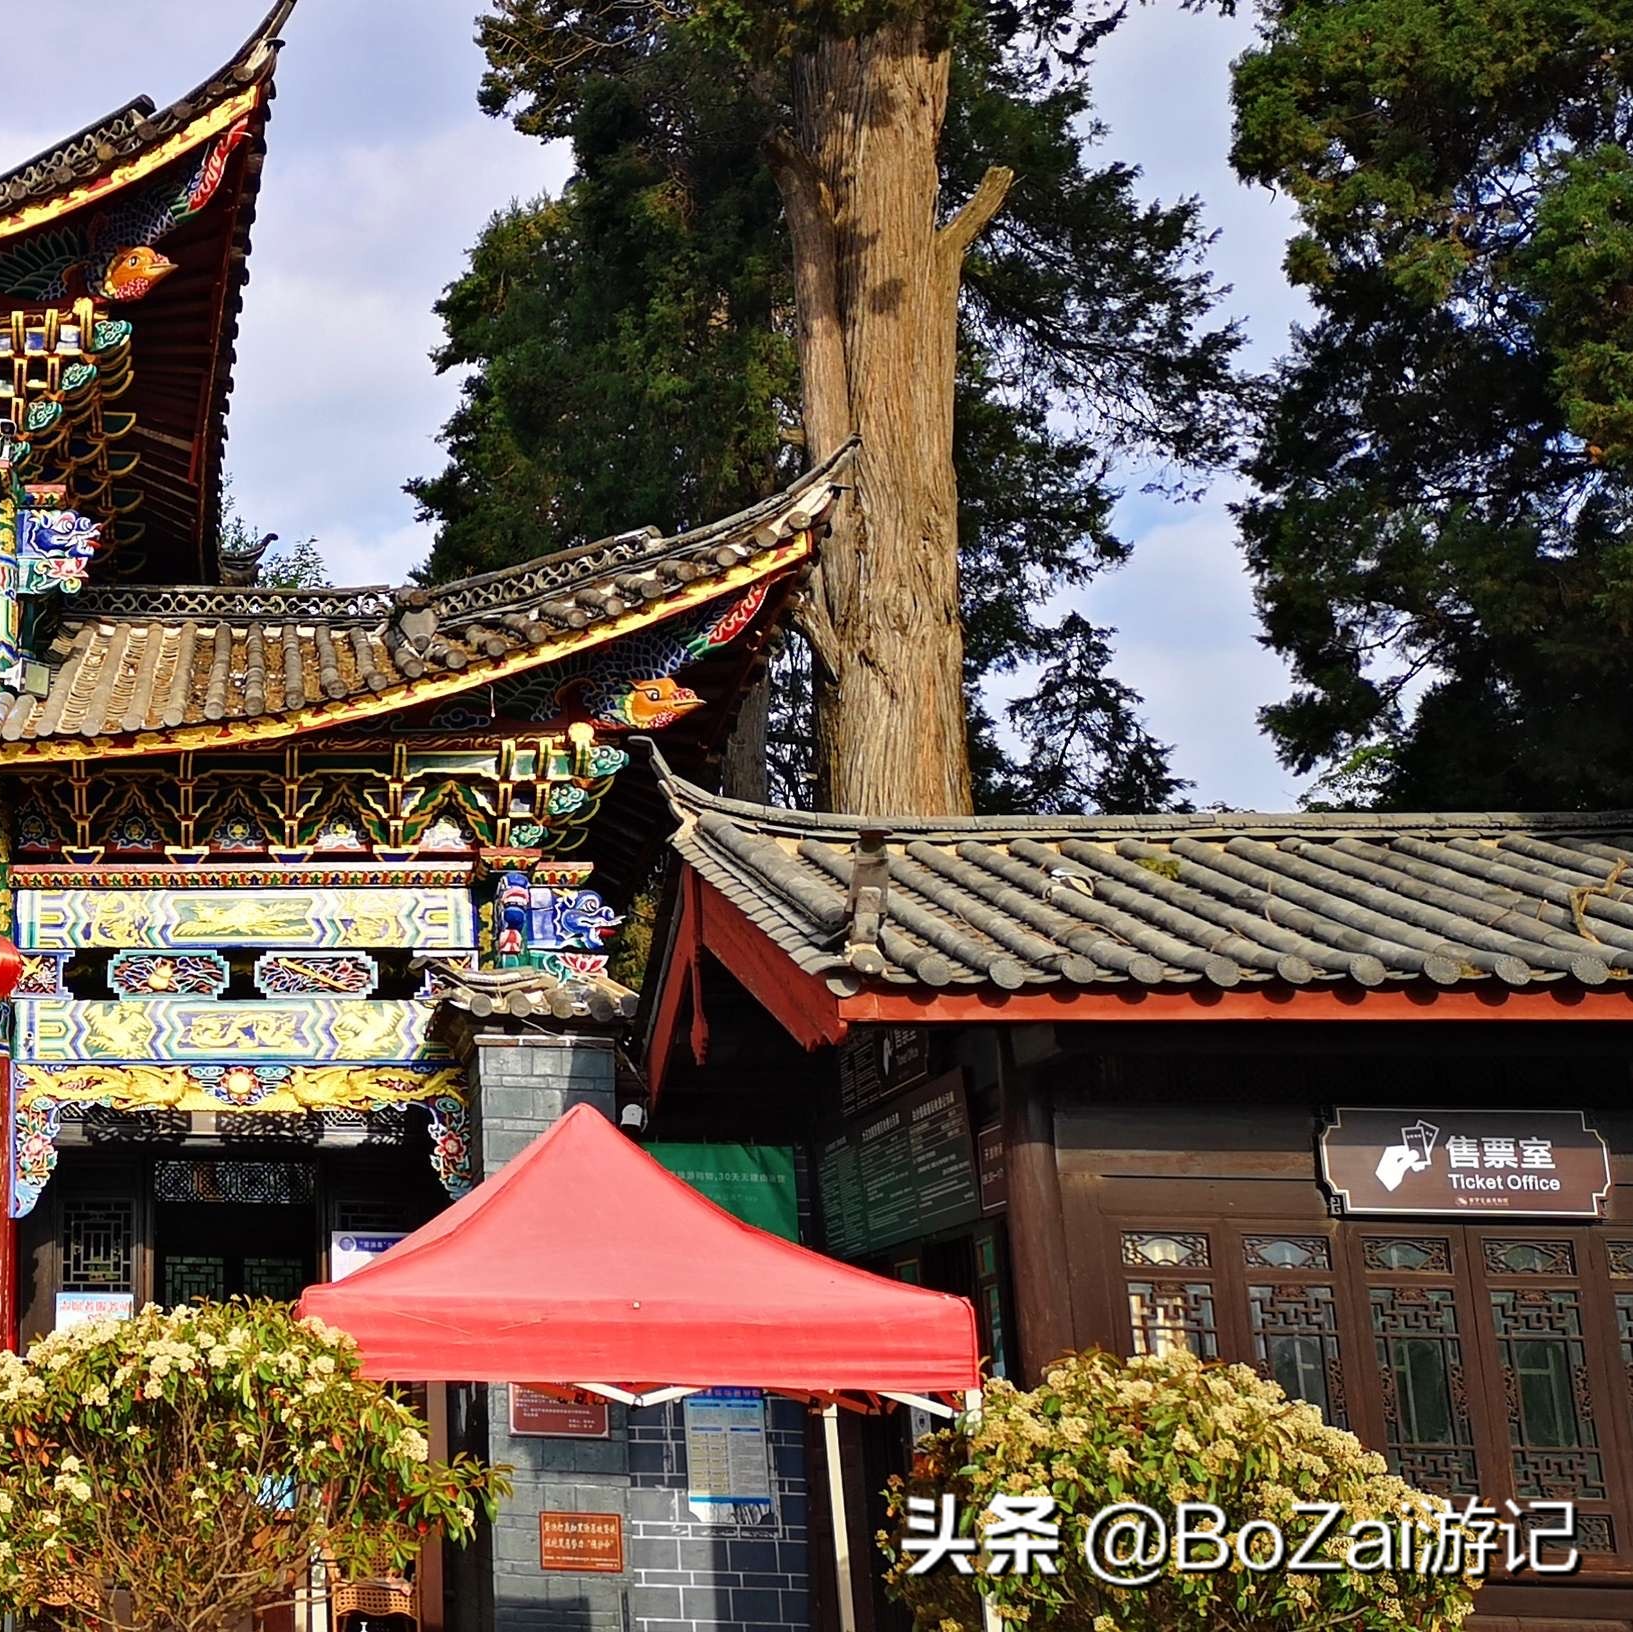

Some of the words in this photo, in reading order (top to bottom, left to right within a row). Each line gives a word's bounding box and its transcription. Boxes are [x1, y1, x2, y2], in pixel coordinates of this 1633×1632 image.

[1446, 1135, 1556, 1169] 售票室
[1448, 1174, 1504, 1190] Ticket
[1507, 1174, 1561, 1191] Office
